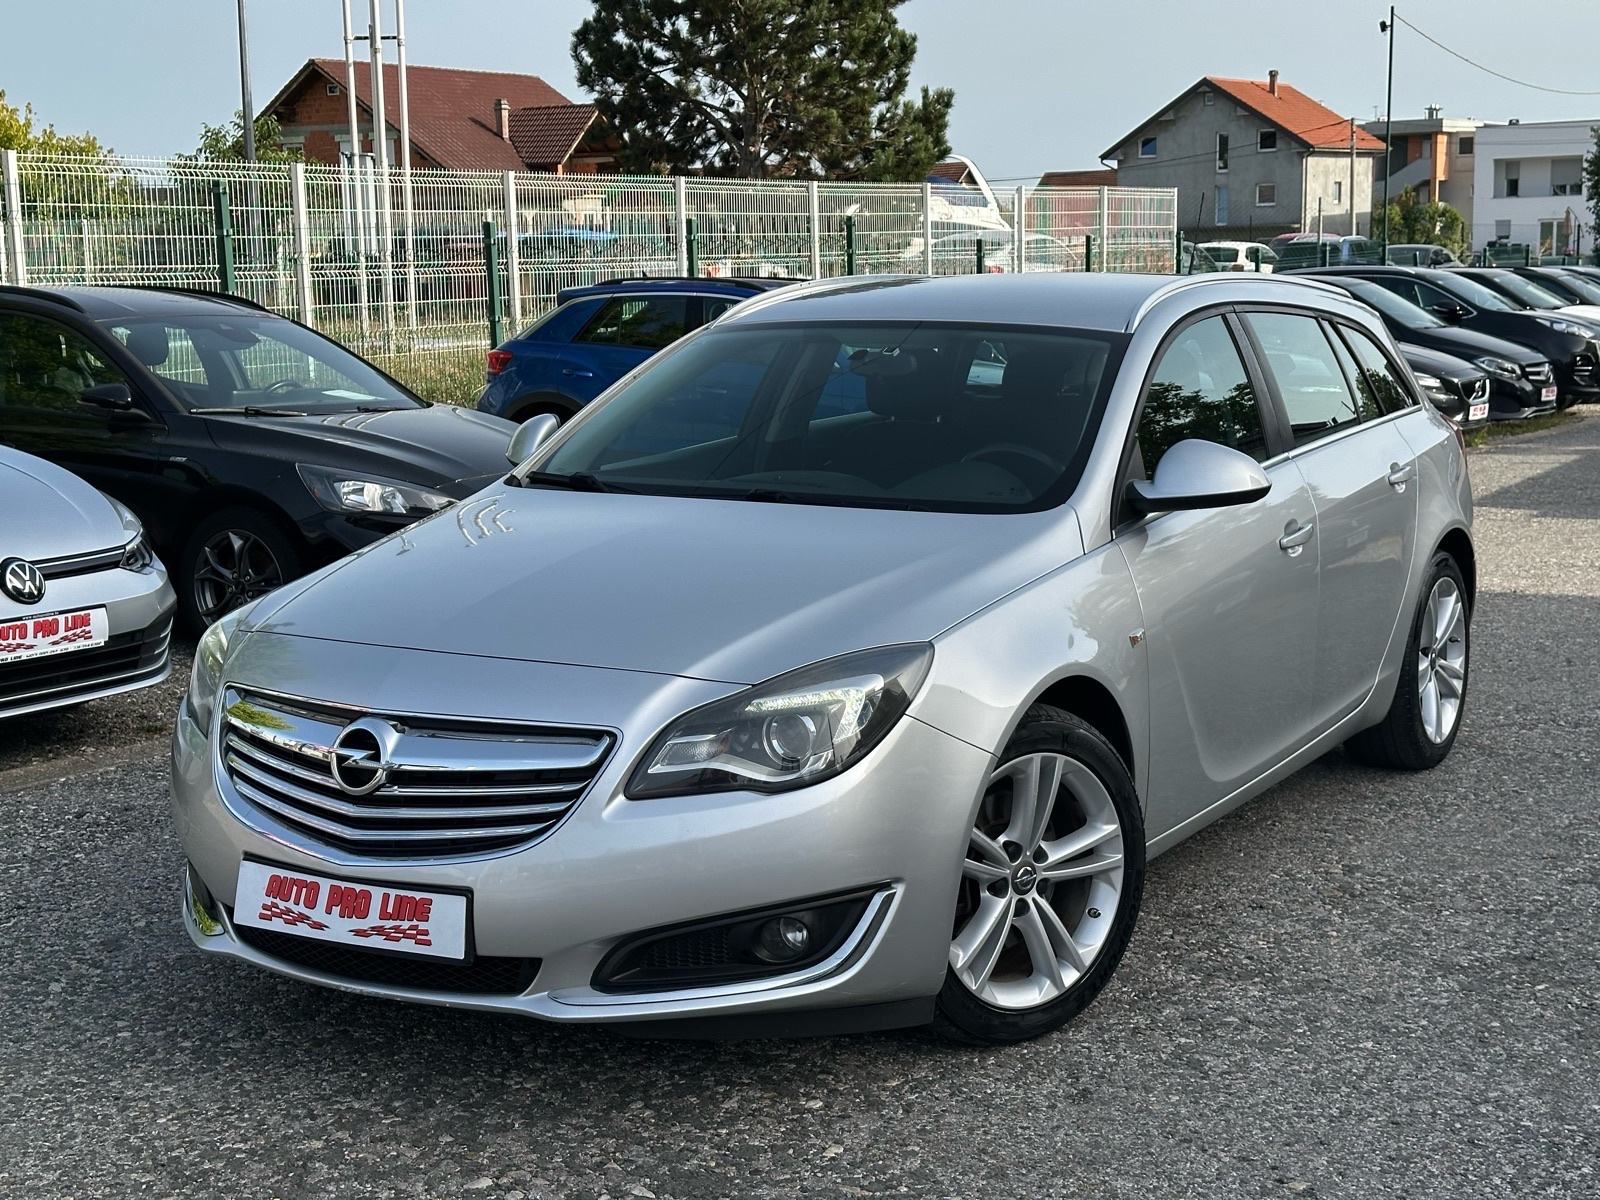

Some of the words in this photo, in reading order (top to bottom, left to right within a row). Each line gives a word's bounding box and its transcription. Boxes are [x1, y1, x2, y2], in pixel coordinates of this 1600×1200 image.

[0, 622, 27, 641] UTO
[33, 618, 59, 639] PRO
[65, 612, 91, 632] LINE
[265, 873, 320, 910] AUTO
[325, 884, 372, 920] PRO
[379, 892, 433, 923] LINE
